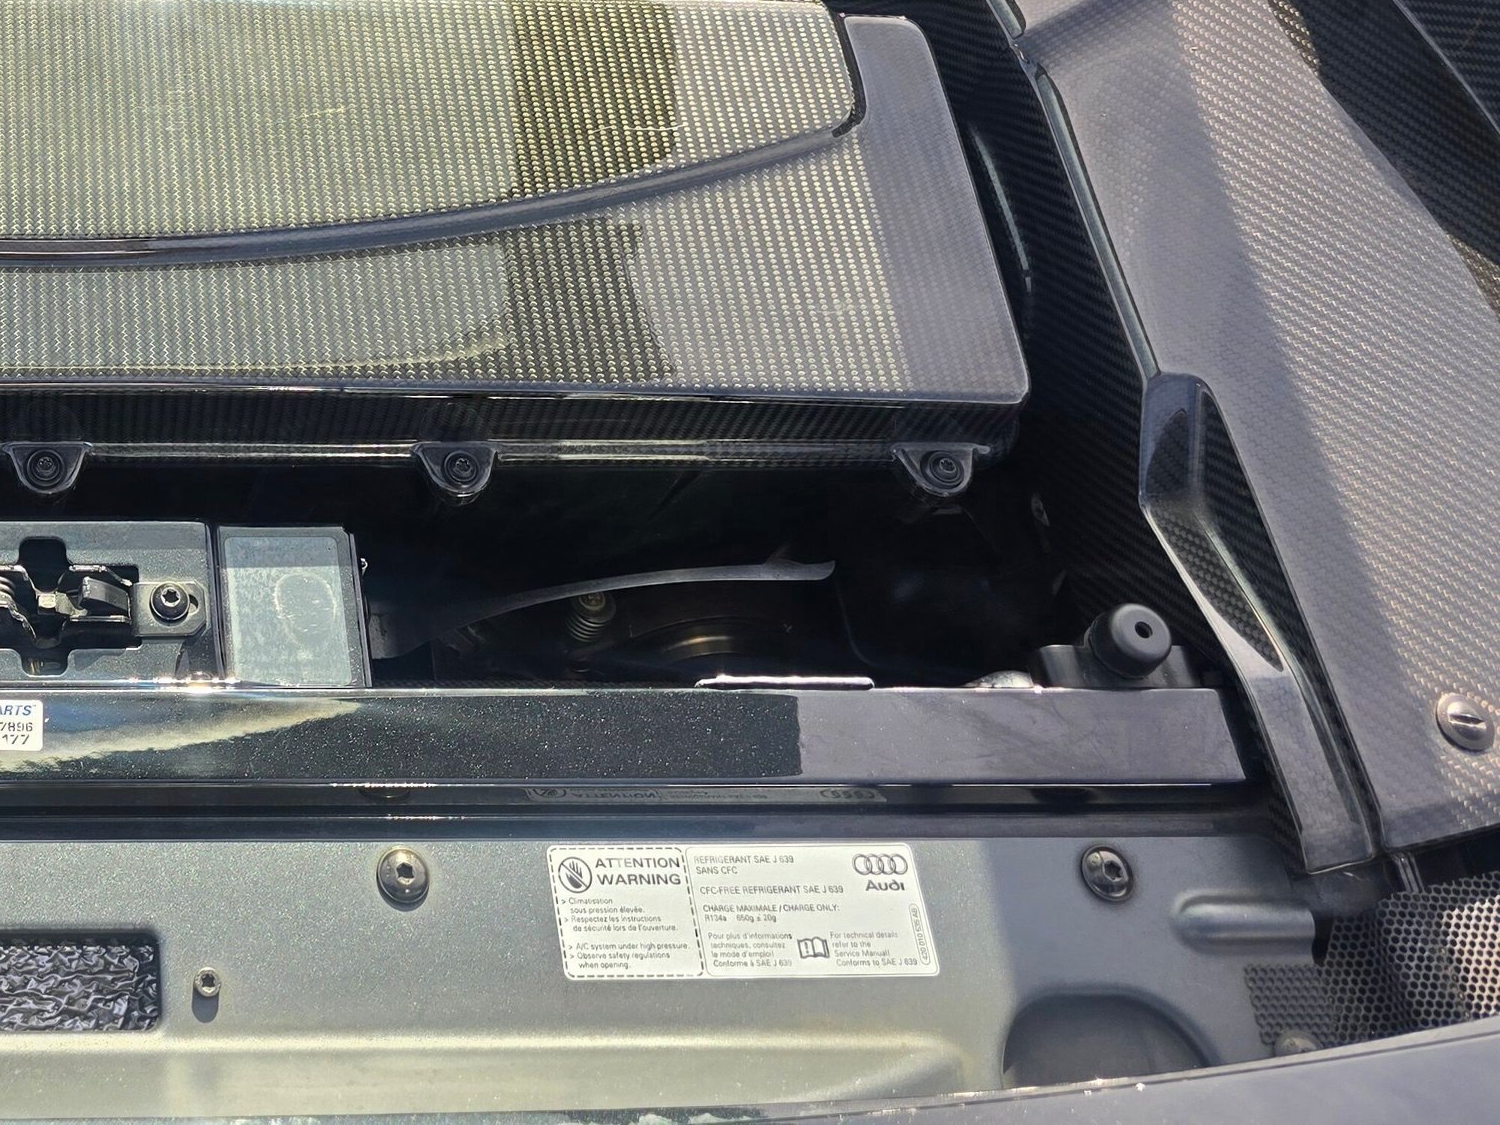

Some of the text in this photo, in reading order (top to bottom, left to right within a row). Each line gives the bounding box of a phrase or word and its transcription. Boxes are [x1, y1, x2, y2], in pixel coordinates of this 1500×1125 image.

[595, 857, 680, 868] ATTENTION
[693, 855, 794, 864] REFRIGERANT SAE J 639
[695, 866, 738, 875] SANS CFC
[596, 873, 681, 885] WARNING
[865, 879, 906, 891] Audi
[700, 885, 844, 895] CFC-FREE REFRIGERANT SAE J 639
[569, 897, 613, 905] Climatisation
[588, 906, 618, 915] pression
[703, 904, 735, 913] CHARGE
[736, 904, 778, 912] MAXIMALE
[783, 904, 815, 912] CHARGE
[816, 903, 840, 912] ONLY:
[571, 916, 608, 924] Respectez
[620, 915, 662, 923] instructions
[704, 914, 727, 922] R134a
[763, 914, 777, 923] 20g
[725, 932, 741, 941] plus
[830, 931, 841, 939] For
[576, 942, 589, 950] A/C
[590, 943, 616, 952] system
[640, 942, 655, 952] high
[608, 951, 630, 960] safety
[632, 951, 670, 960] regulations
[756, 959, 771, 967] SAE
